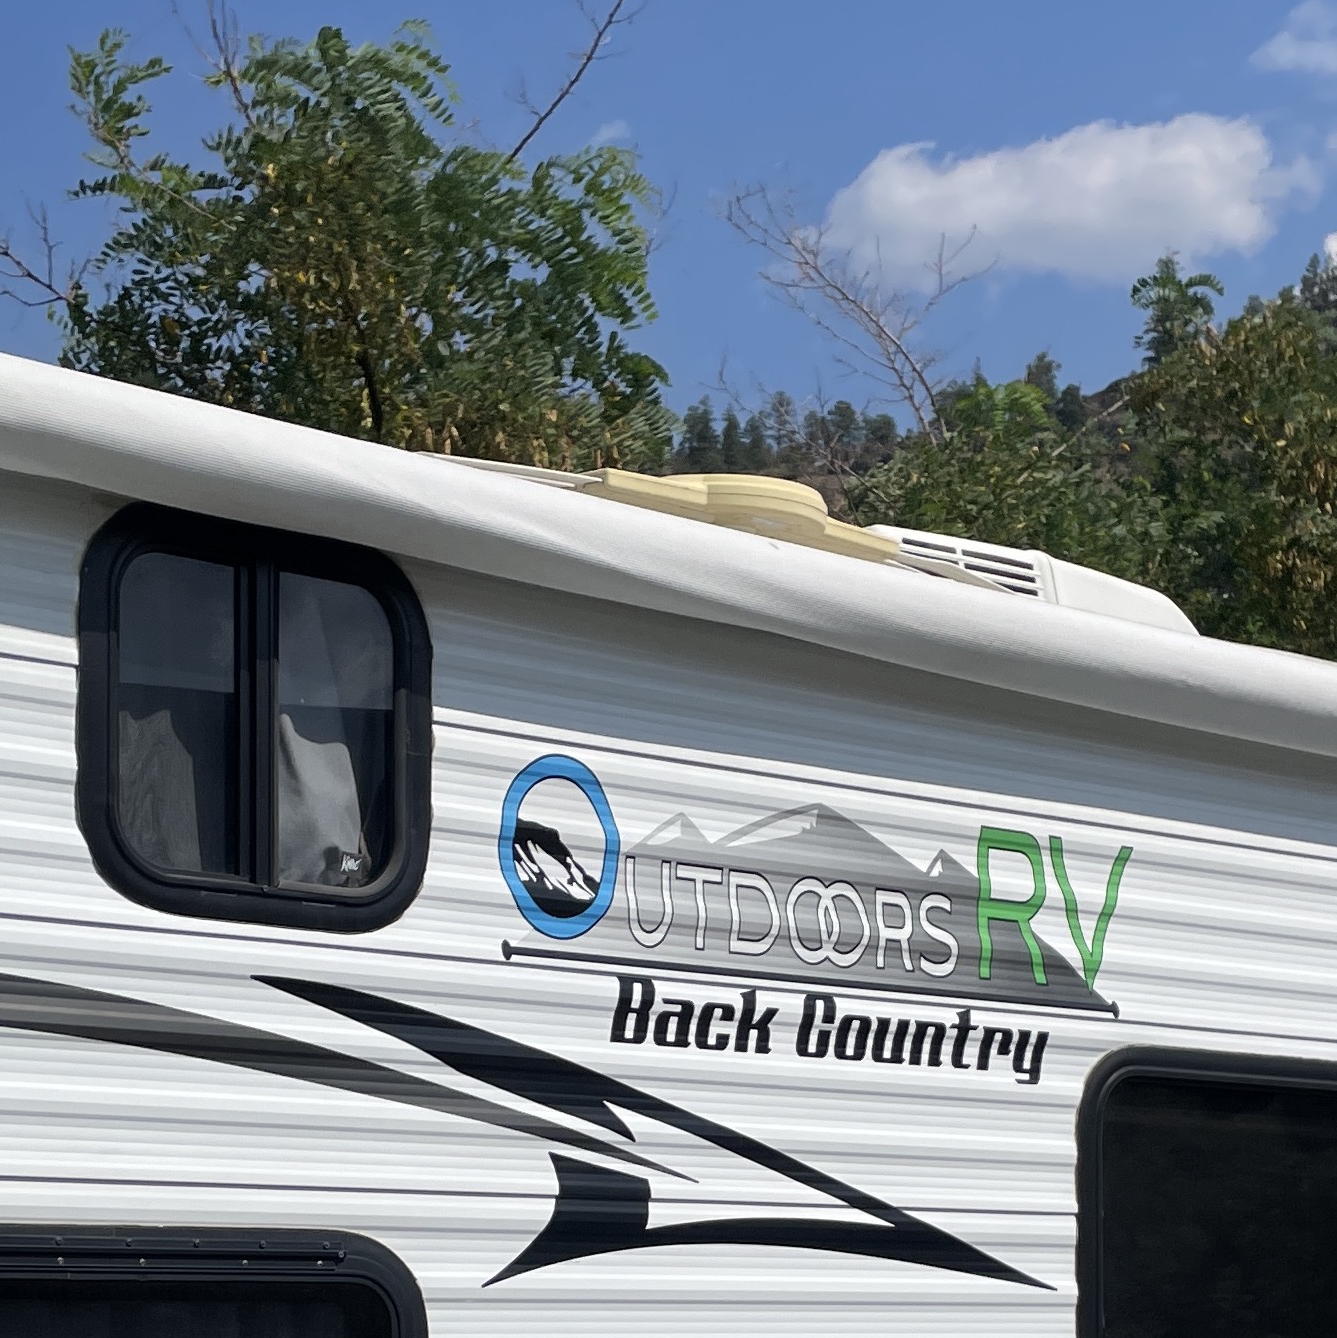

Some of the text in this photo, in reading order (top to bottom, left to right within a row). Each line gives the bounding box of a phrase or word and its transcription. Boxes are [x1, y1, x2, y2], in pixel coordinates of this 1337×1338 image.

[498, 753, 1134, 995] OUTDOORS RV
[609, 976, 1051, 1085] Back Country
